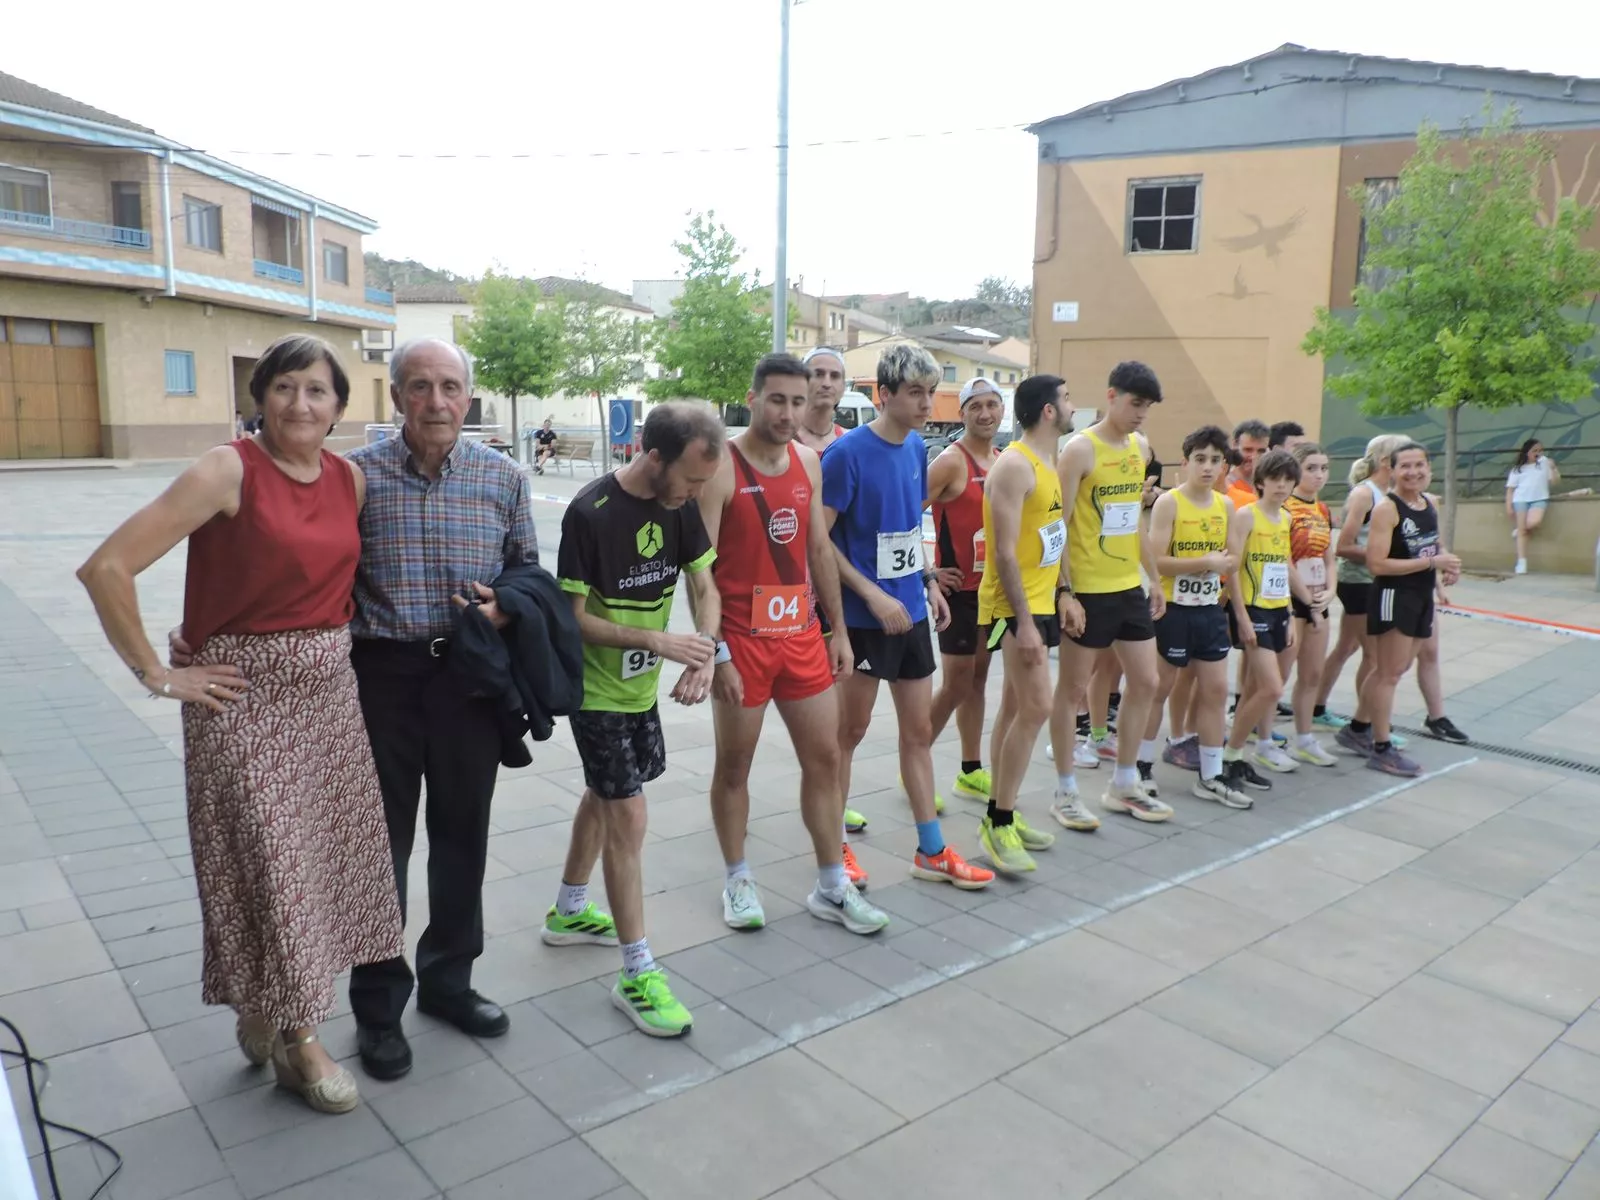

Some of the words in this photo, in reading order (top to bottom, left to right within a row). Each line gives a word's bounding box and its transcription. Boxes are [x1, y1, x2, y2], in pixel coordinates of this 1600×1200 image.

[1121, 511, 1129, 527] 5
[892, 547, 916, 571] 36
[767, 595, 800, 622] 04
